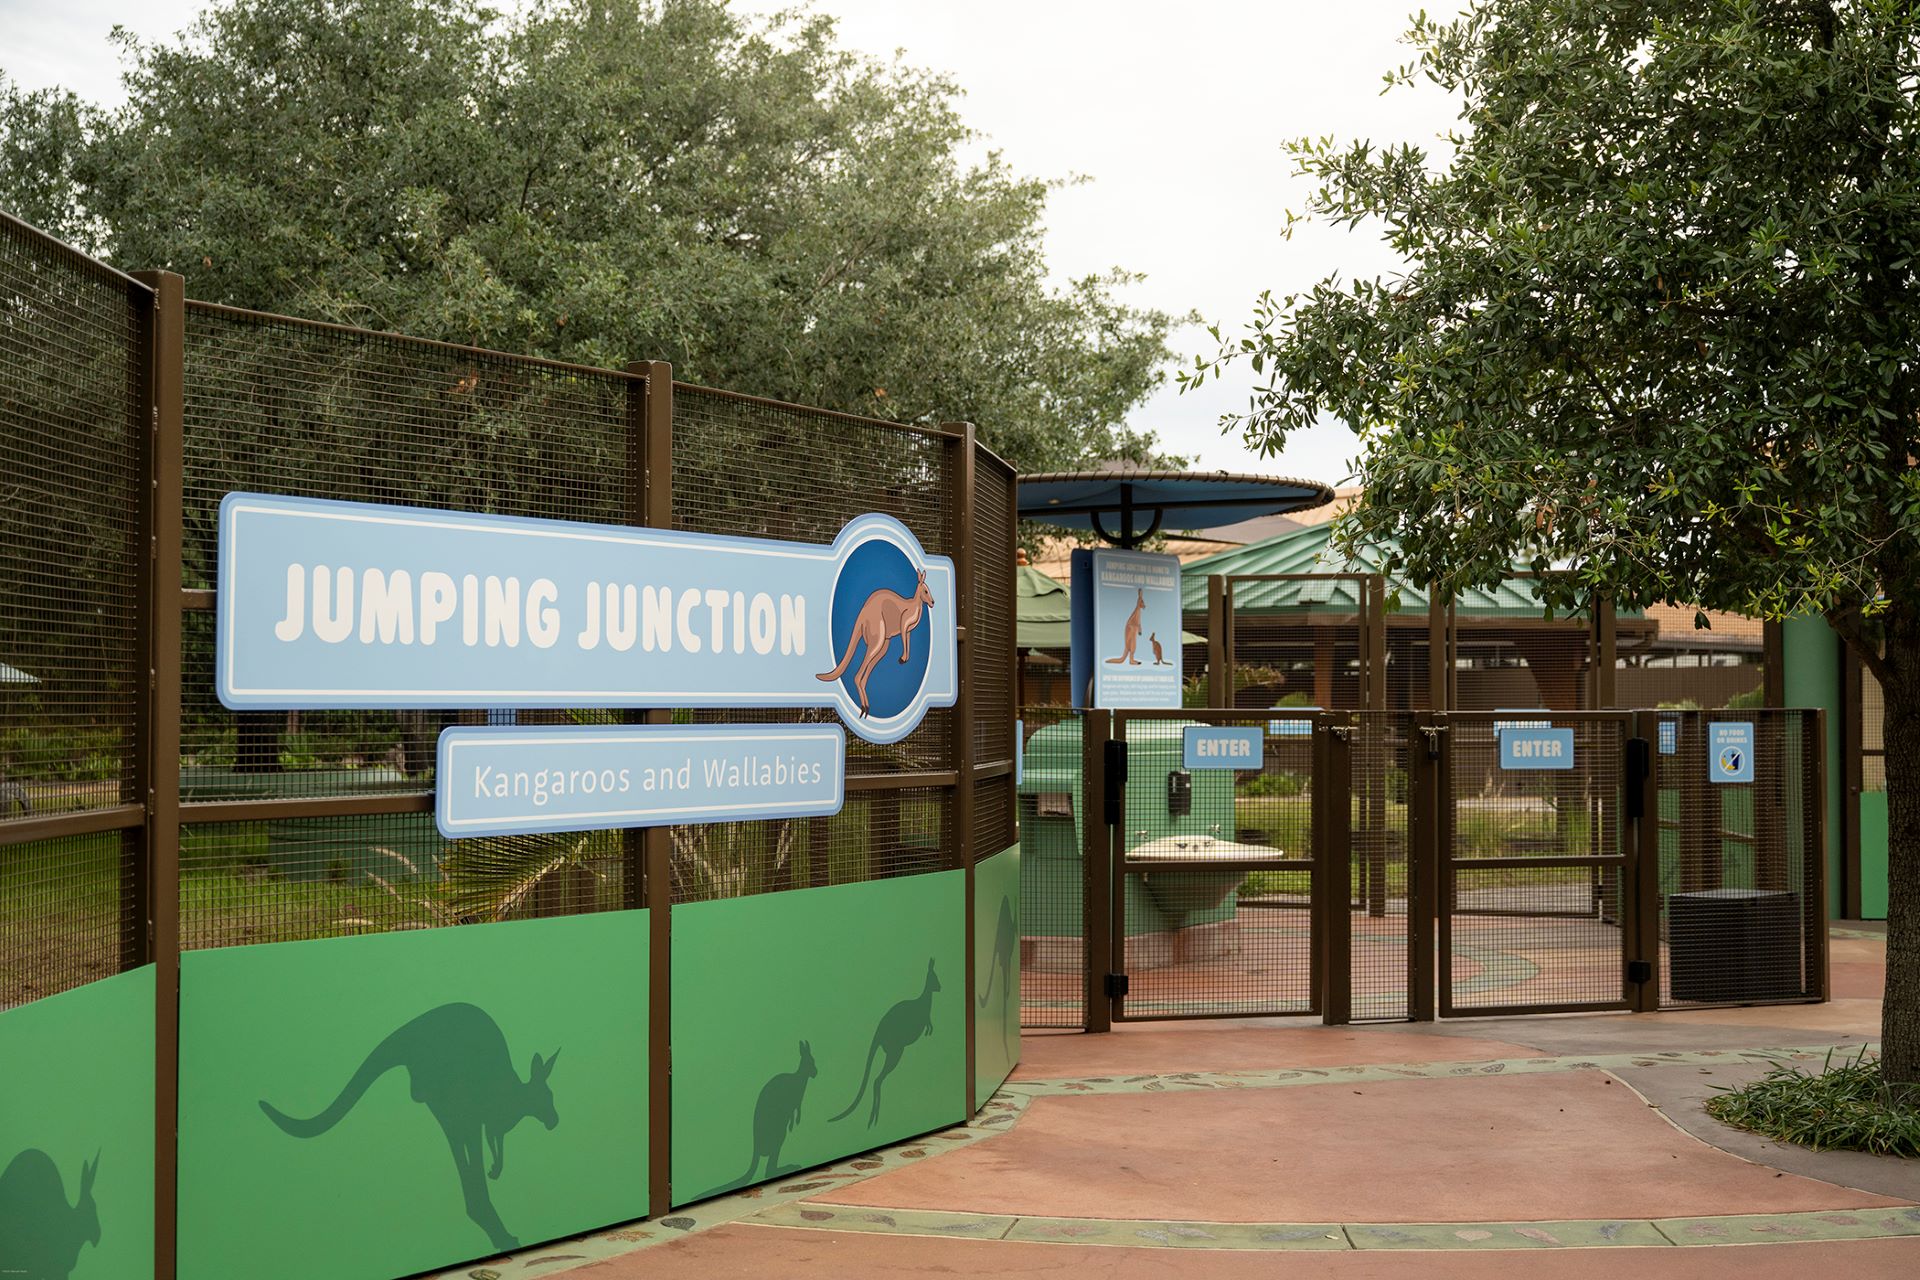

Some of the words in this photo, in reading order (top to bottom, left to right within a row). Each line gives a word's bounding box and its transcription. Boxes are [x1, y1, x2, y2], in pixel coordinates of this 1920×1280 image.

[275, 564, 560, 648] JUMPING
[578, 582, 806, 656] JUNCTION
[1197, 739, 1250, 757] ENTER
[1512, 740, 1562, 757] ENTER
[475, 764, 630, 805] Kangaroos
[643, 758, 691, 791] and
[703, 756, 822, 788] Wallabies
